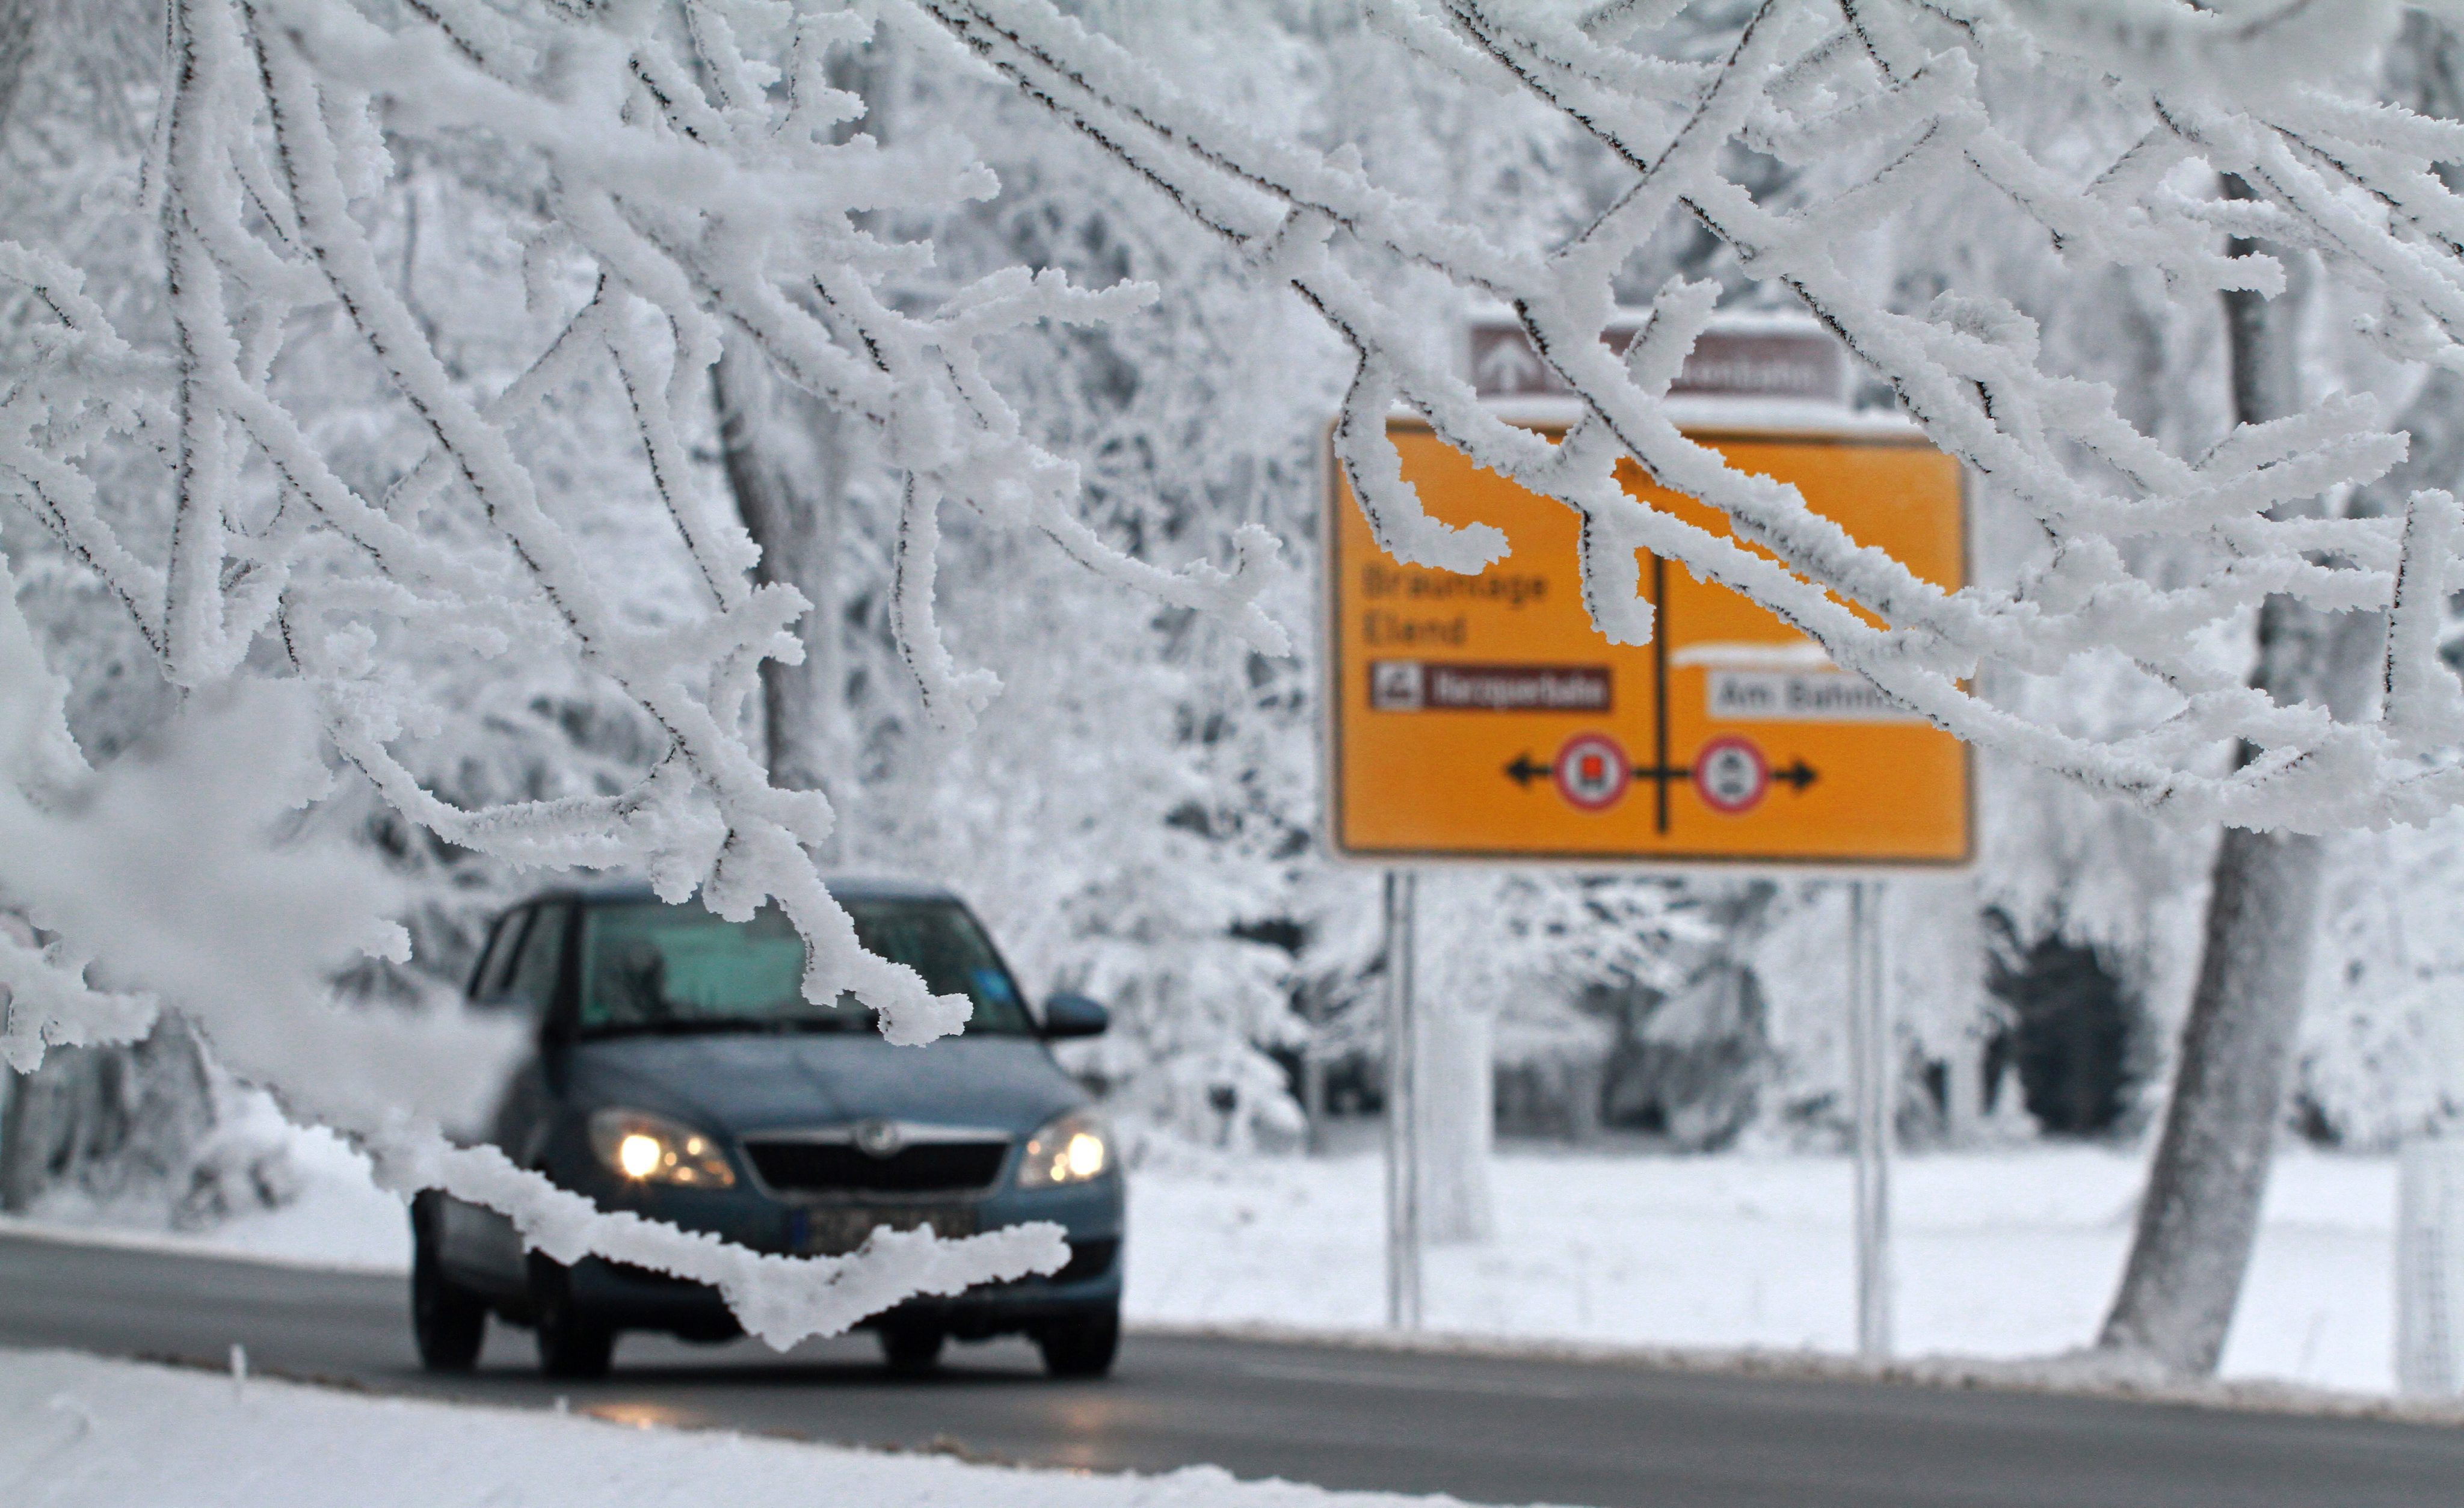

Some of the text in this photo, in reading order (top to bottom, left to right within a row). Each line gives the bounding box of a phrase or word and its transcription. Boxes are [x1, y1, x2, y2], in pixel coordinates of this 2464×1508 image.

[1364, 564, 1548, 610] Braunlage
[1363, 611, 1466, 645] Elend
[1719, 677, 1775, 706] Am
